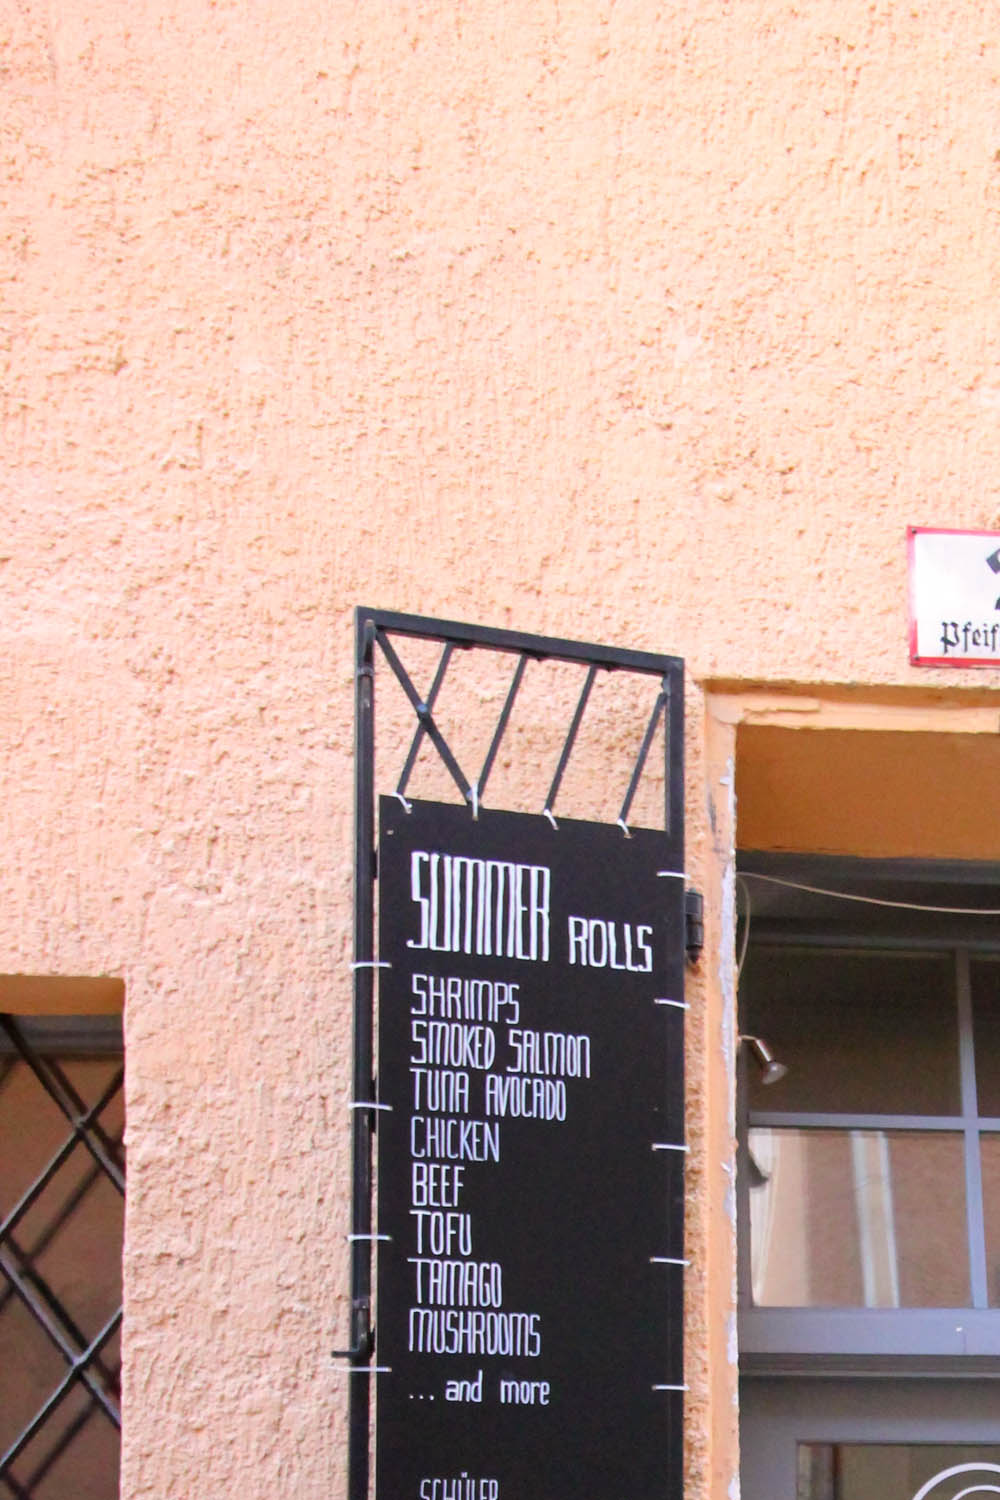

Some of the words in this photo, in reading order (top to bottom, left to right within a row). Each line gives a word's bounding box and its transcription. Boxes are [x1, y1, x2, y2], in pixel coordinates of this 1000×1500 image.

[407, 850, 550, 962] SUMMER
[568, 915, 653, 972] ROLLS
[410, 973, 520, 1024] SHRIMPS
[410, 1019, 495, 1070] SMOKED
[506, 1028, 591, 1079] SALMON
[409, 1067, 469, 1113] TUNA
[486, 1074, 567, 1121] AVOCADO
[410, 1116, 500, 1162] CHICKEN
[412, 1162, 465, 1207] BEEF
[409, 1209, 472, 1255] TOFU
[407, 1257, 502, 1308] TAMAGO
[408, 1308, 541, 1357] MUSHROOMS
[445, 1369, 483, 1402] and
[500, 1380, 550, 1405] more
